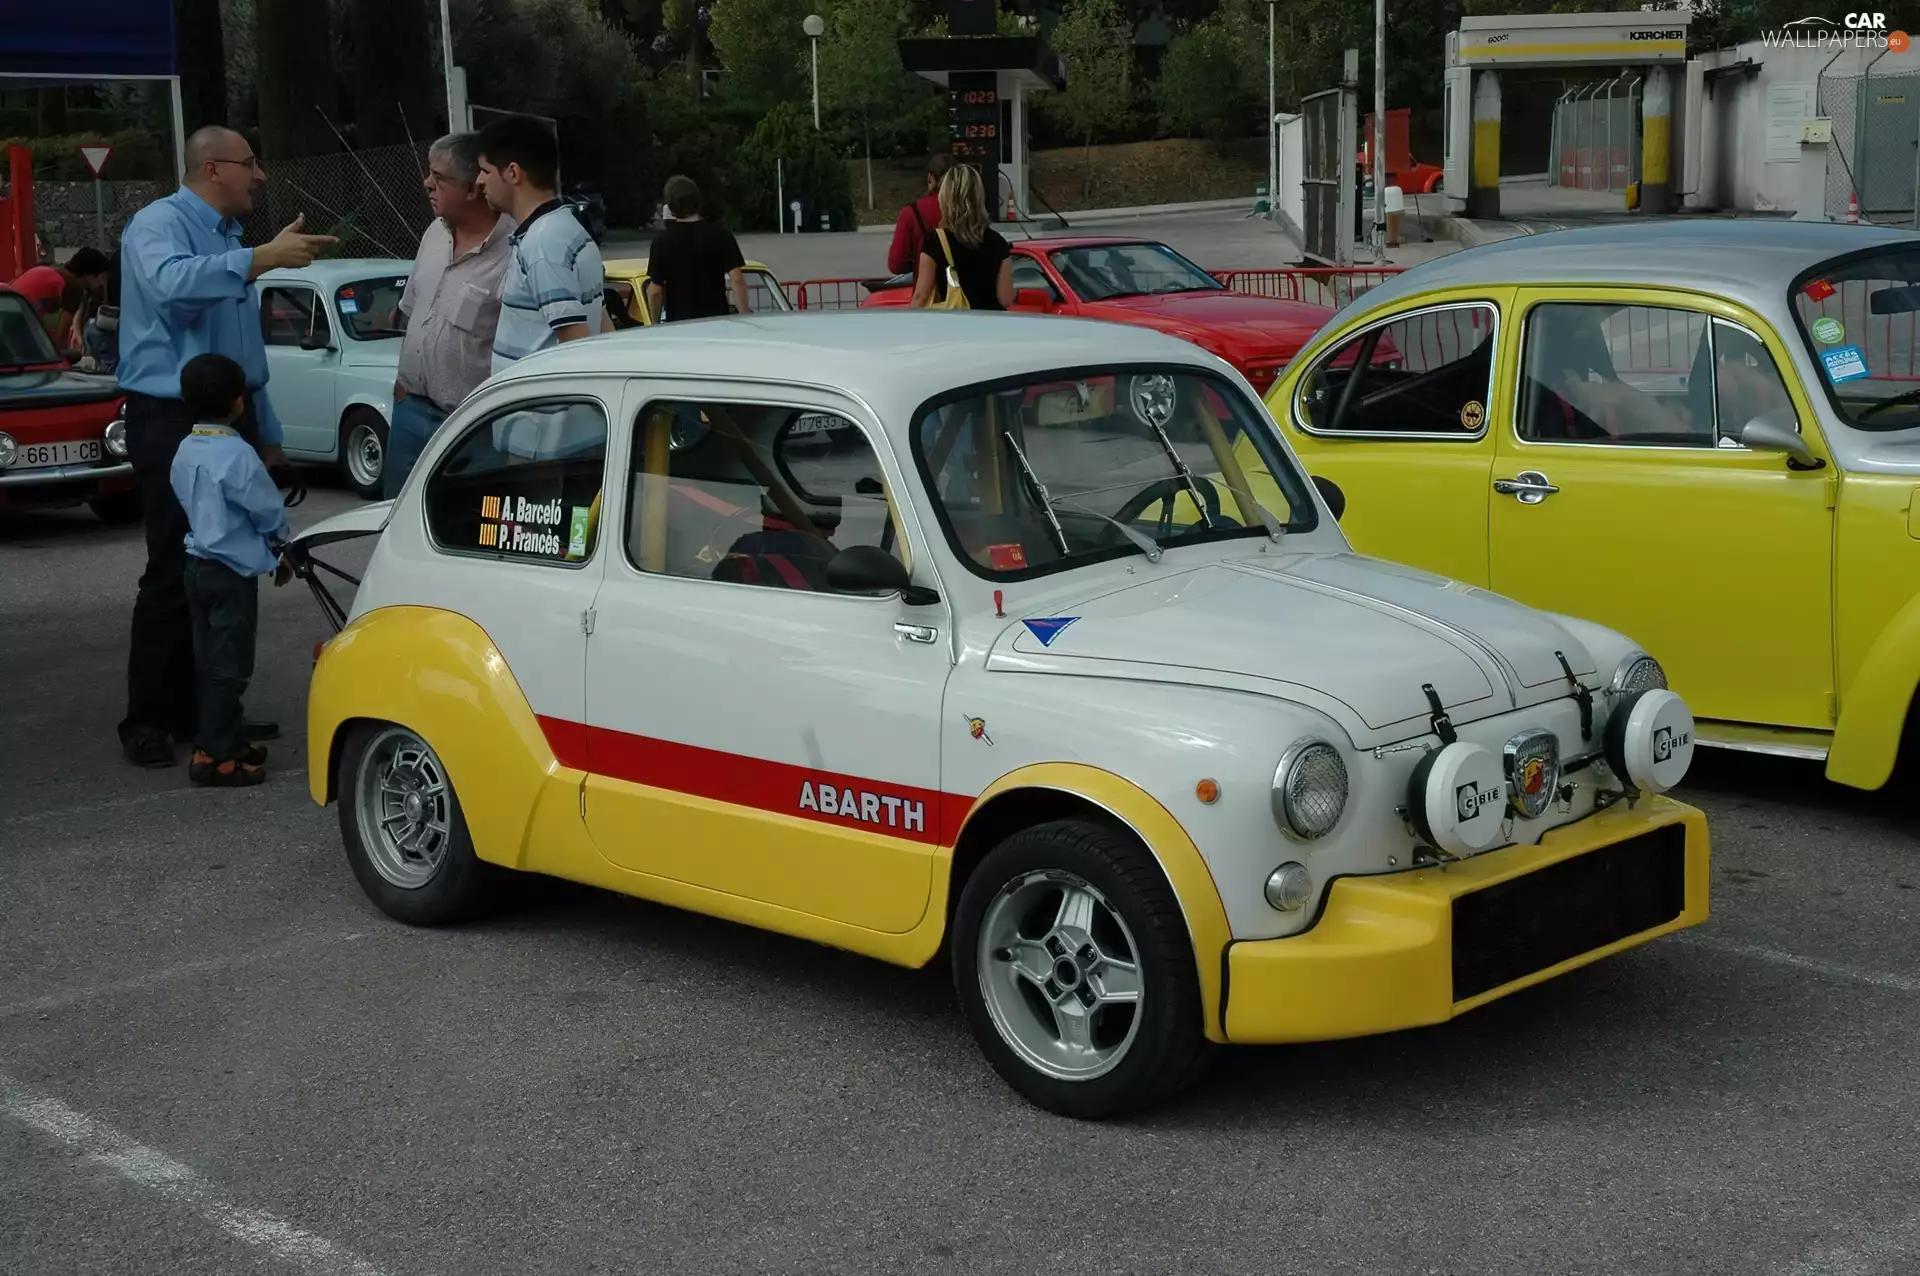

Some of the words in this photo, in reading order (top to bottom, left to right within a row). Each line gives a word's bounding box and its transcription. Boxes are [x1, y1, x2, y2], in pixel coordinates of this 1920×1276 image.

[501, 495, 514, 521] A.
[516, 496, 562, 525] Barceló
[498, 524, 510, 550] P.
[512, 525, 560, 555] Francès
[798, 781, 924, 832] ABARTH
